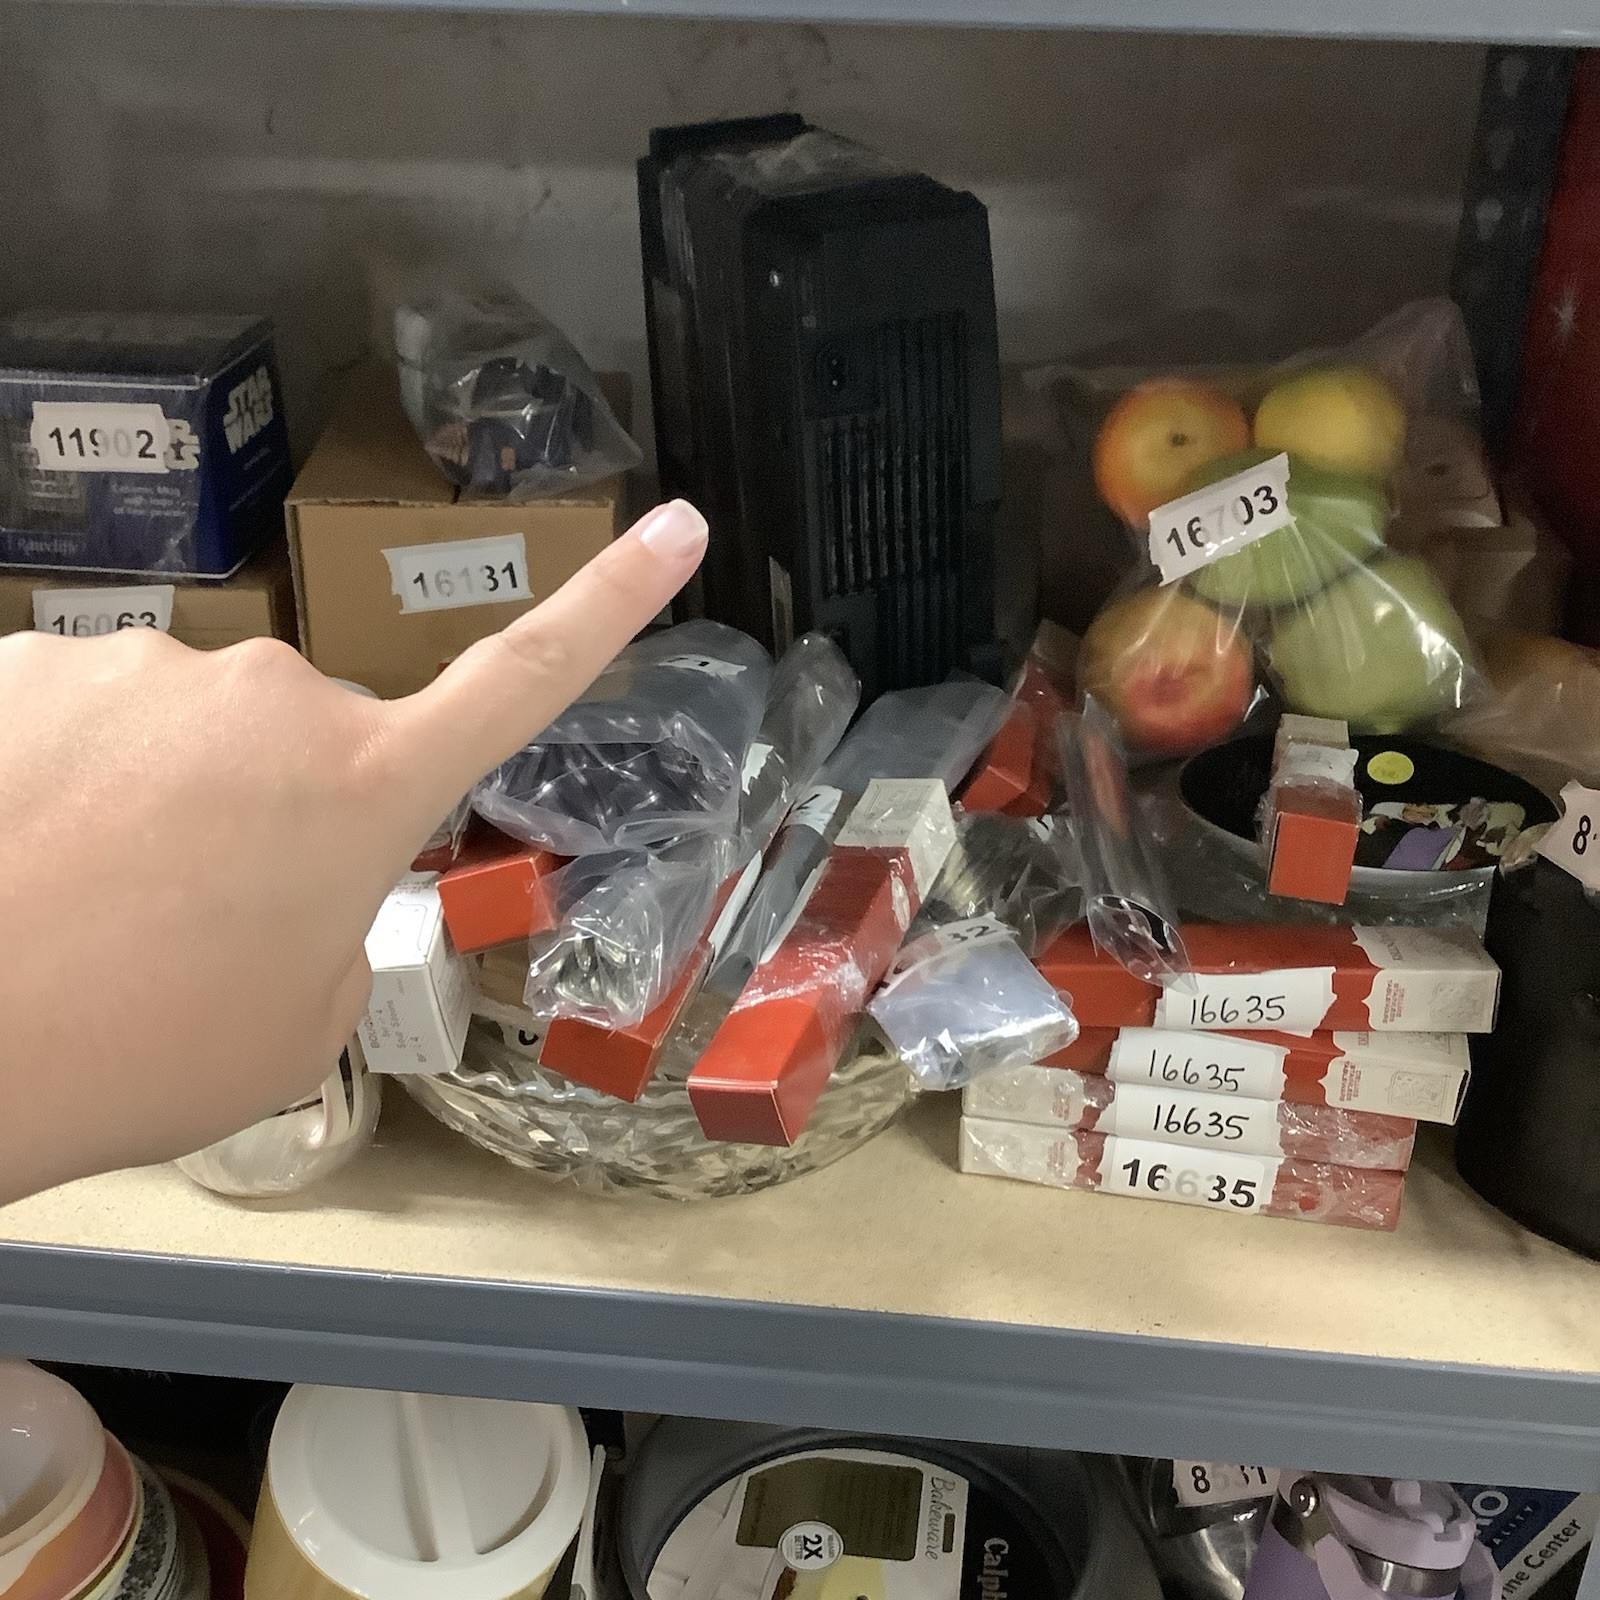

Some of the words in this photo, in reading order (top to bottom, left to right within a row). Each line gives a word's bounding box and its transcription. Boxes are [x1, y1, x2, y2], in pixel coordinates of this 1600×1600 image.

[49, 427, 156, 459] 11902
[1167, 485, 1279, 557] 16703
[413, 561, 518, 599] 16131
[1190, 996, 1286, 1025] 16635
[1149, 1049, 1245, 1092] 16635
[1153, 1104, 1250, 1141] 16635
[1122, 1158, 1257, 1208] 16635
[925, 1476, 956, 1560] Bakeware
[1493, 1506, 1533, 1545] ALITY
[803, 1534, 823, 1561] 2X
[1502, 1571, 1530, 1600] ine
[1523, 1519, 1581, 1569] Center
